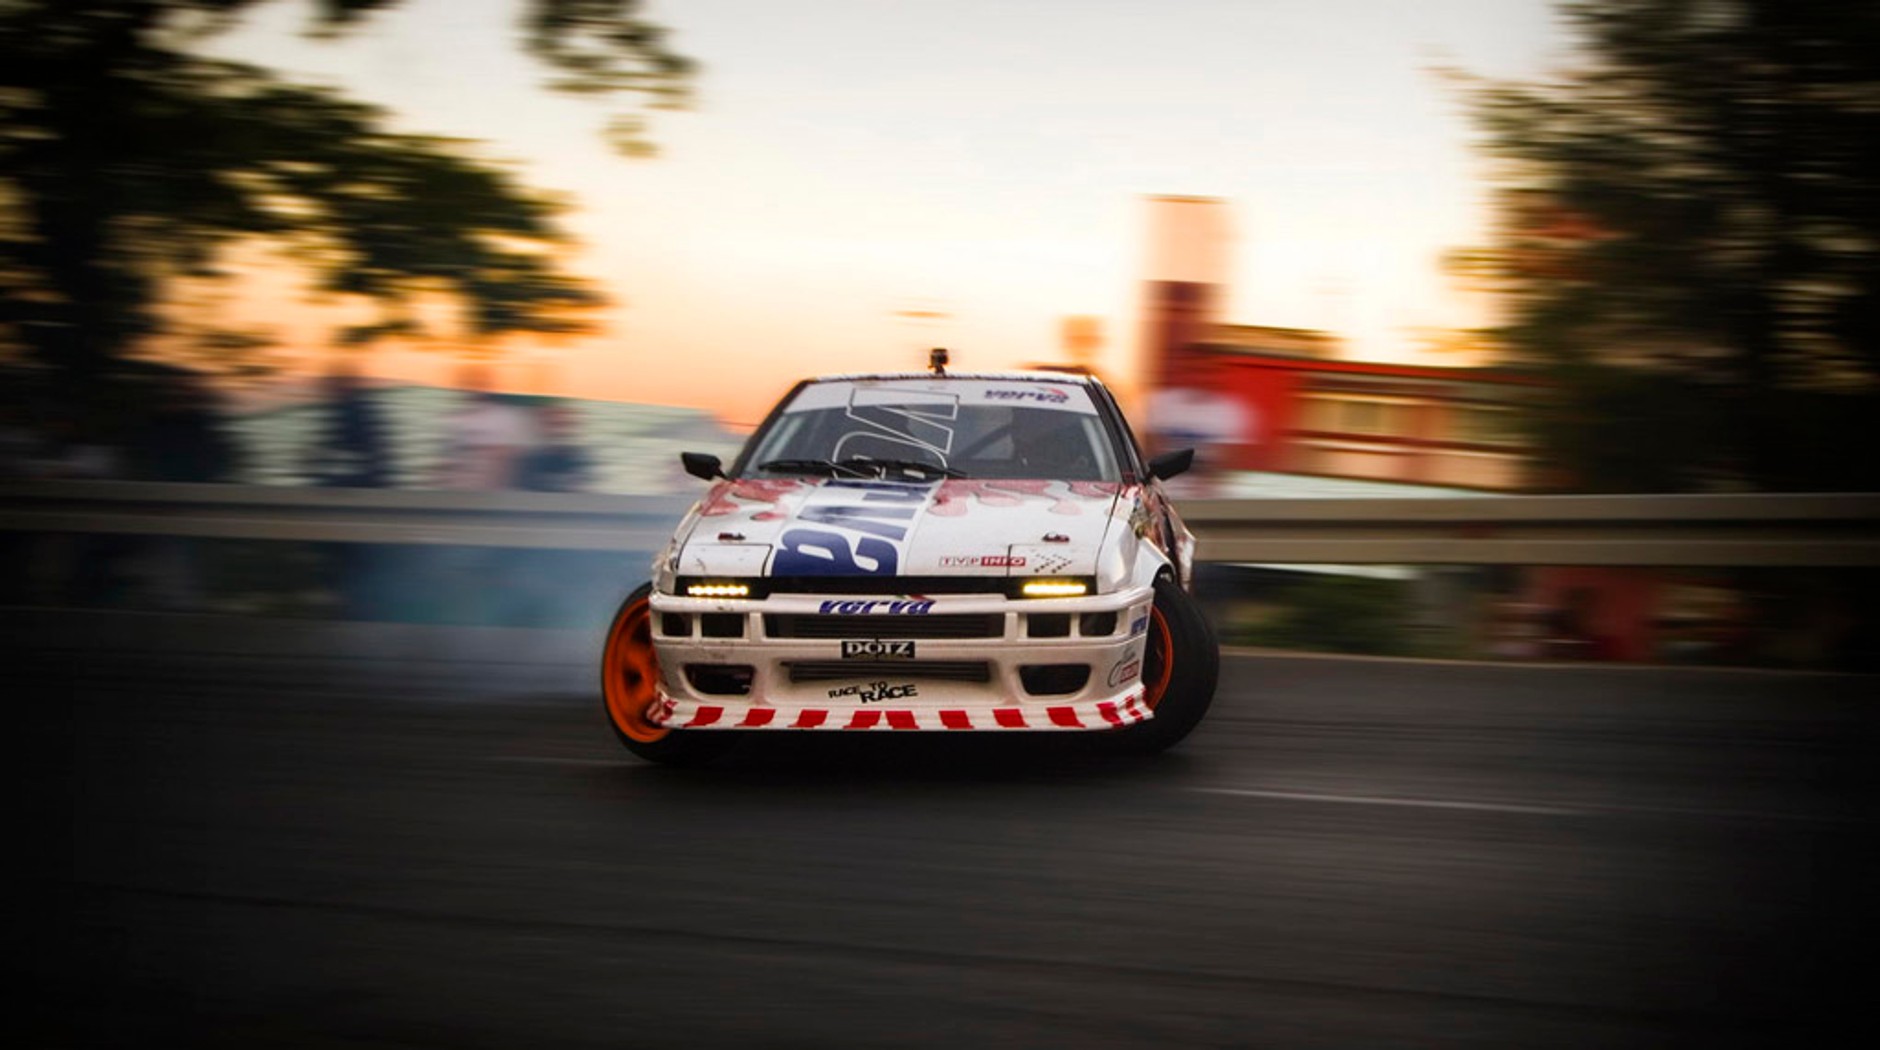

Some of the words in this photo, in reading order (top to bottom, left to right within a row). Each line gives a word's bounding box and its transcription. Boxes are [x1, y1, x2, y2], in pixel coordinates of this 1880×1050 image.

[985, 389, 1069, 403] verva
[981, 556, 1025, 567] INFO
[819, 600, 936, 614] verva
[846, 641, 911, 655] DOTZ
[828, 685, 861, 698] RACE
[859, 683, 919, 703] RACE
[868, 681, 888, 692] TO
